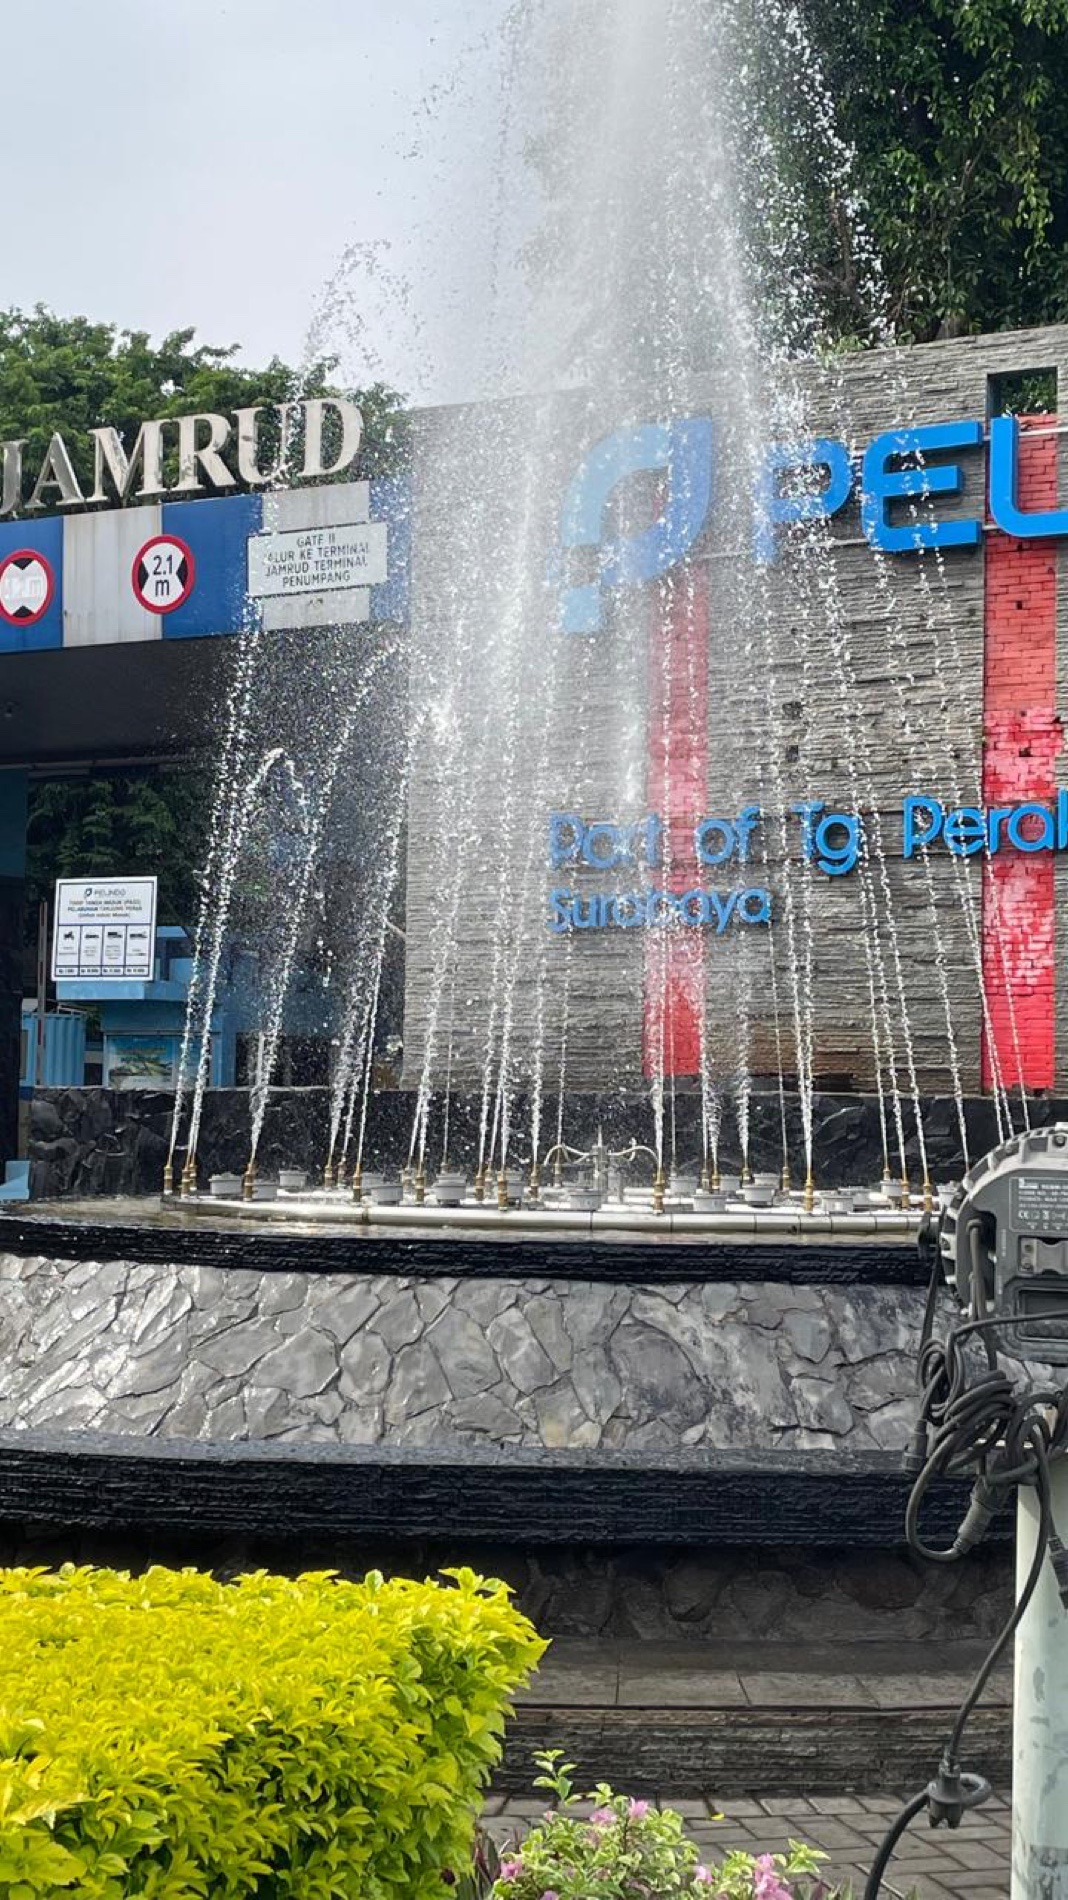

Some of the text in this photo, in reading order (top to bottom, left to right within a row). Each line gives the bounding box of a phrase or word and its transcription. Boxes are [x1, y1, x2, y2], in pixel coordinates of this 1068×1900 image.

[0, 397, 365, 516] JAMRUD
[296, 533, 324, 548] GATE
[299, 548, 313, 560] KE
[316, 542, 369, 558] TERMINAL
[153, 554, 173, 576] 2.1
[264, 554, 369, 576] JAMRUD TERMINAL
[155, 579, 170, 597] m
[282, 570, 351, 588] PENUMPANG
[696, 804, 761, 865] of
[790, 799, 858, 876] Tg
